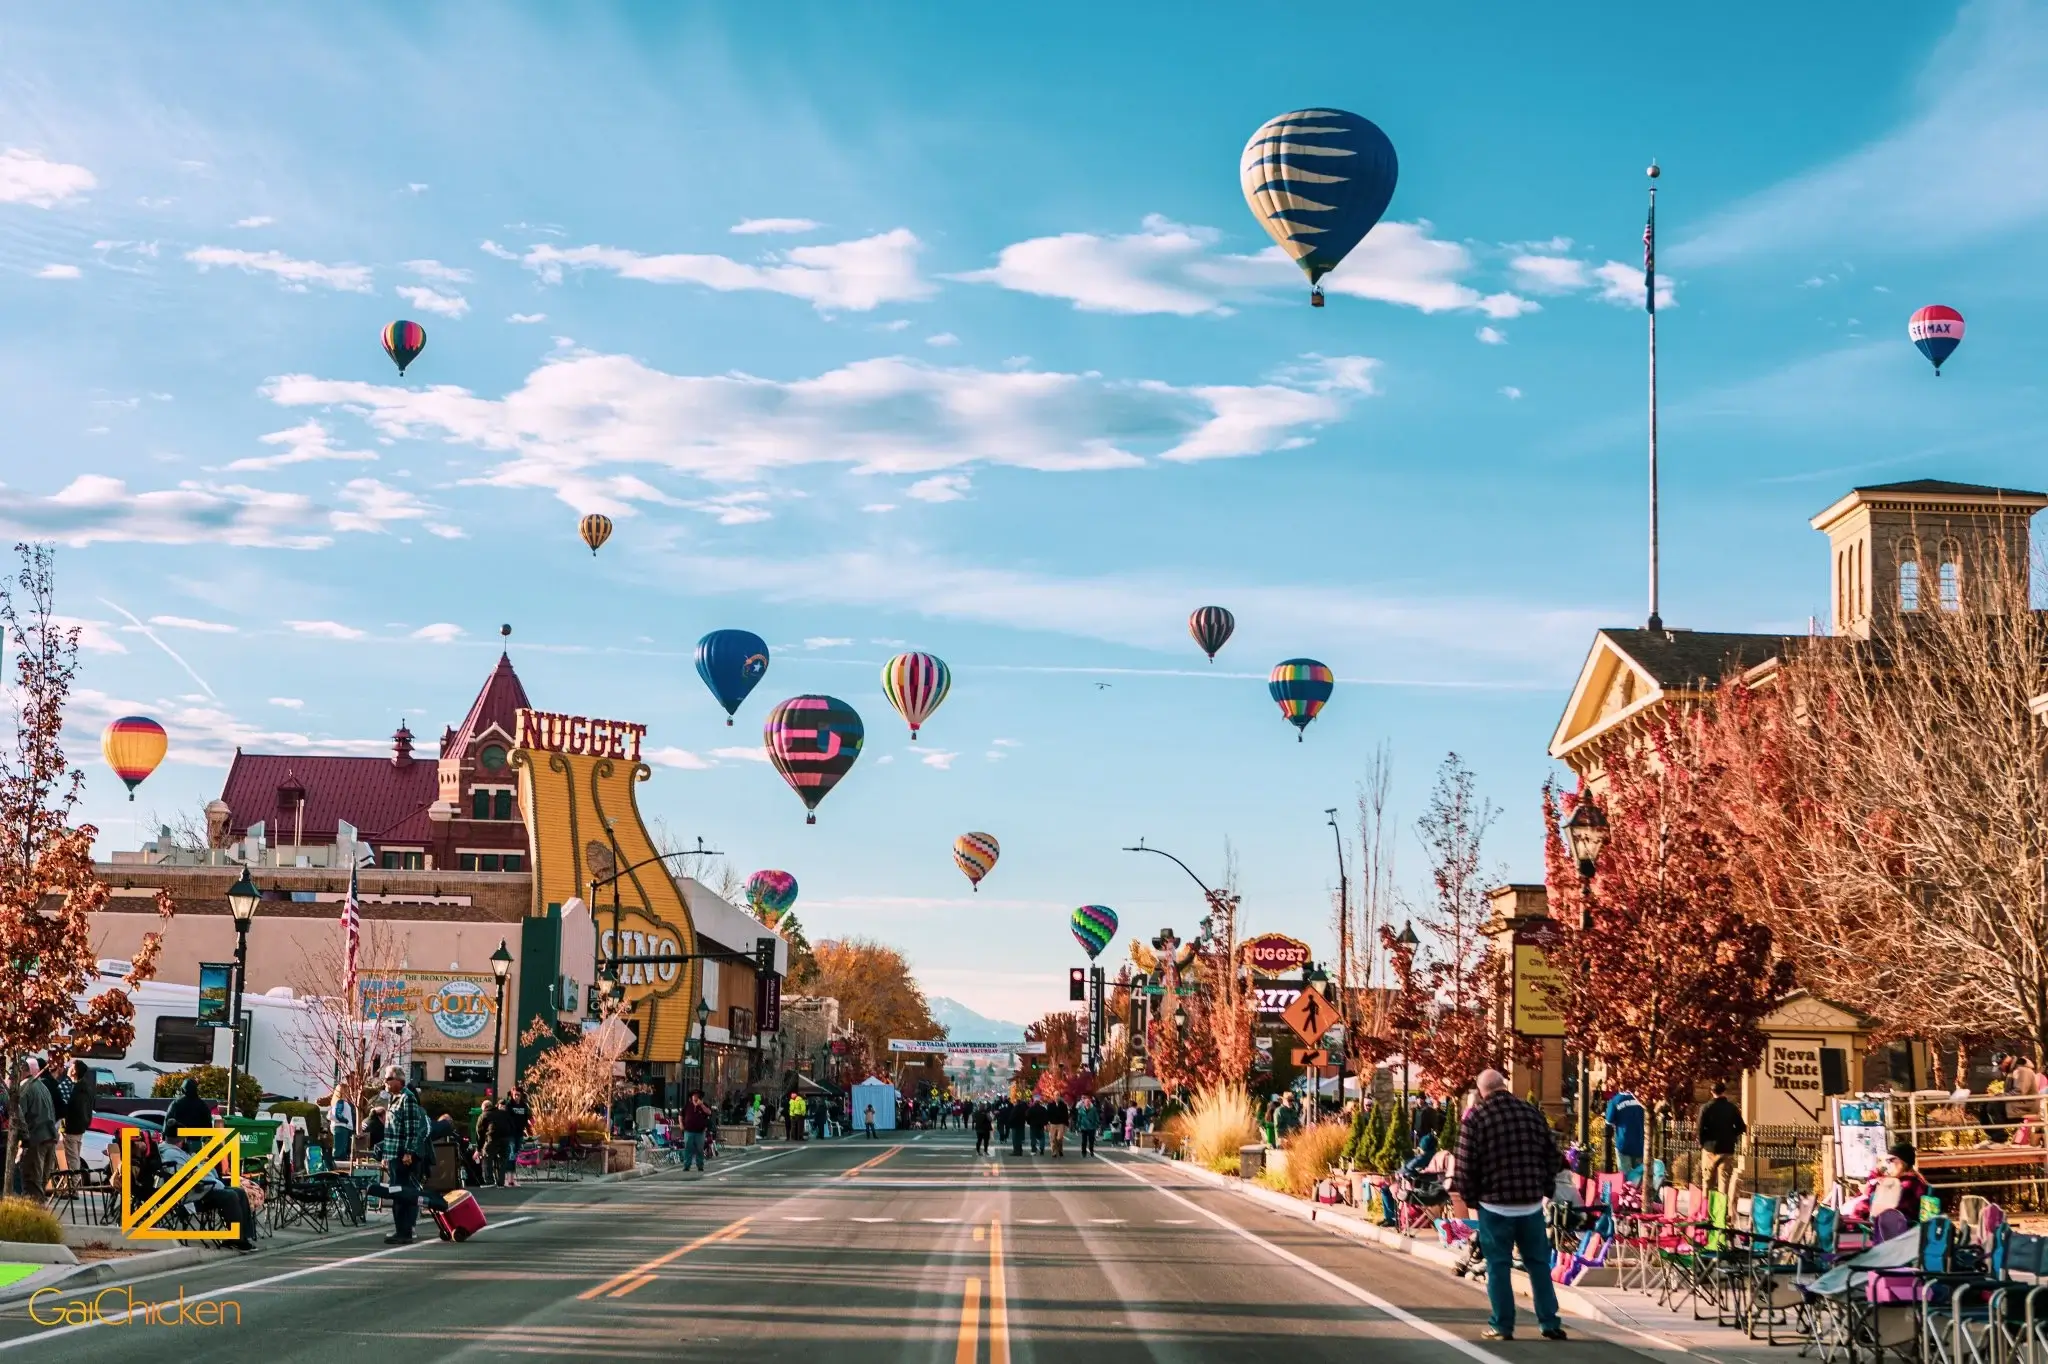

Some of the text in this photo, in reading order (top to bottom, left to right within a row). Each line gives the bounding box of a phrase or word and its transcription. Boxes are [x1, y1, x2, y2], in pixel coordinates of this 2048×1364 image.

[520, 709, 648, 762] NUGGET
[601, 929, 677, 985] SINO
[1520, 973, 1551, 981] Brewery
[423, 992, 497, 1015] COIN
[1520, 1004, 1548, 1012] Nevada
[1528, 1012, 1560, 1020] Museum
[1773, 1047, 1816, 1061] Neva
[1774, 1062, 1819, 1076] State
[1773, 1077, 1820, 1090] Muse
